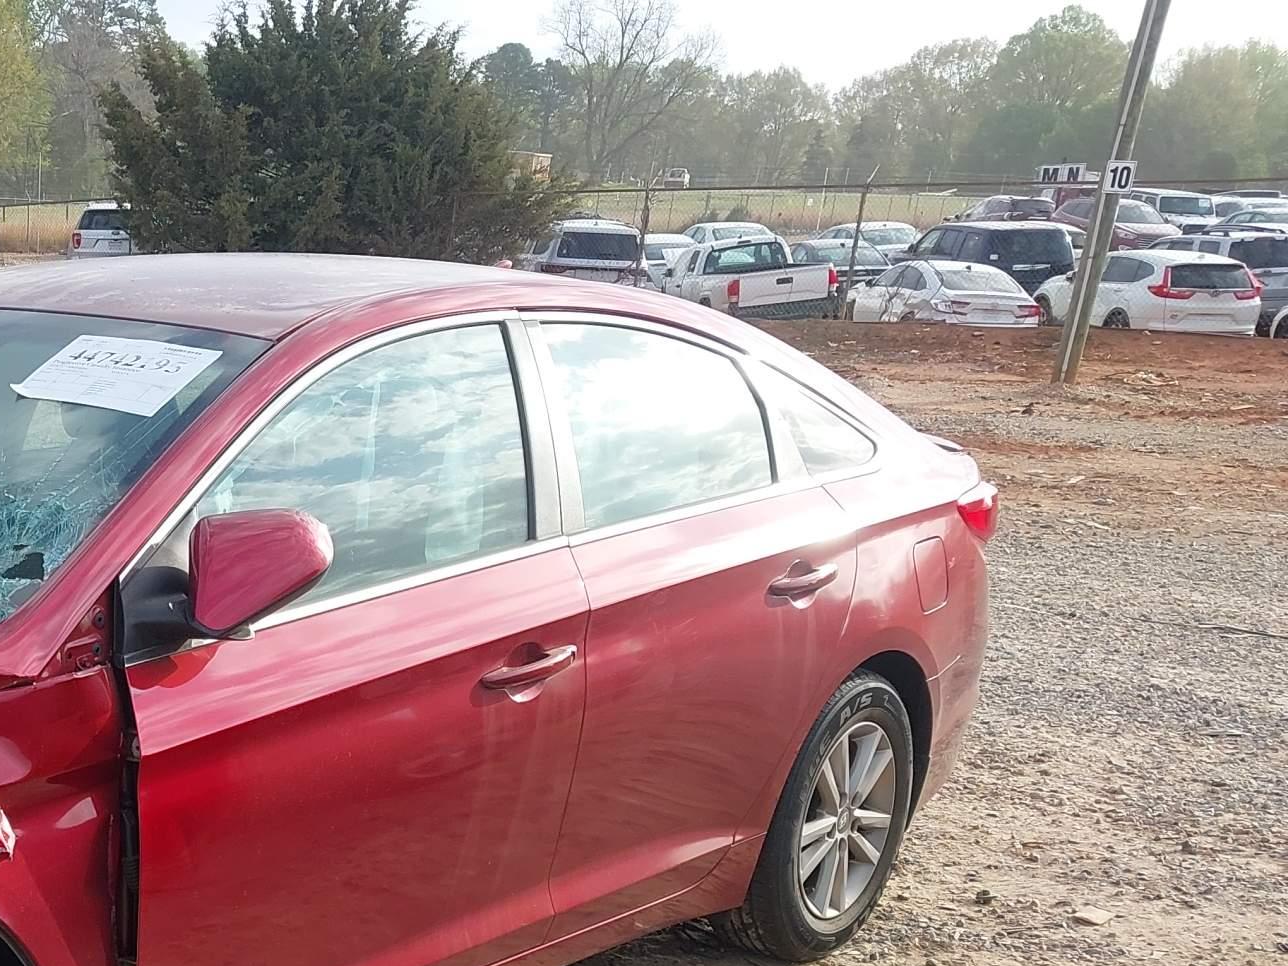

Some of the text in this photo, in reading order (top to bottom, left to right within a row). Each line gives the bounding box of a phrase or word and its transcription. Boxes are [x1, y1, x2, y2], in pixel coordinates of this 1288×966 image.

[1042, 167, 1060, 183] M
[1067, 167, 1080, 183] N
[1110, 166, 1131, 189] 10
